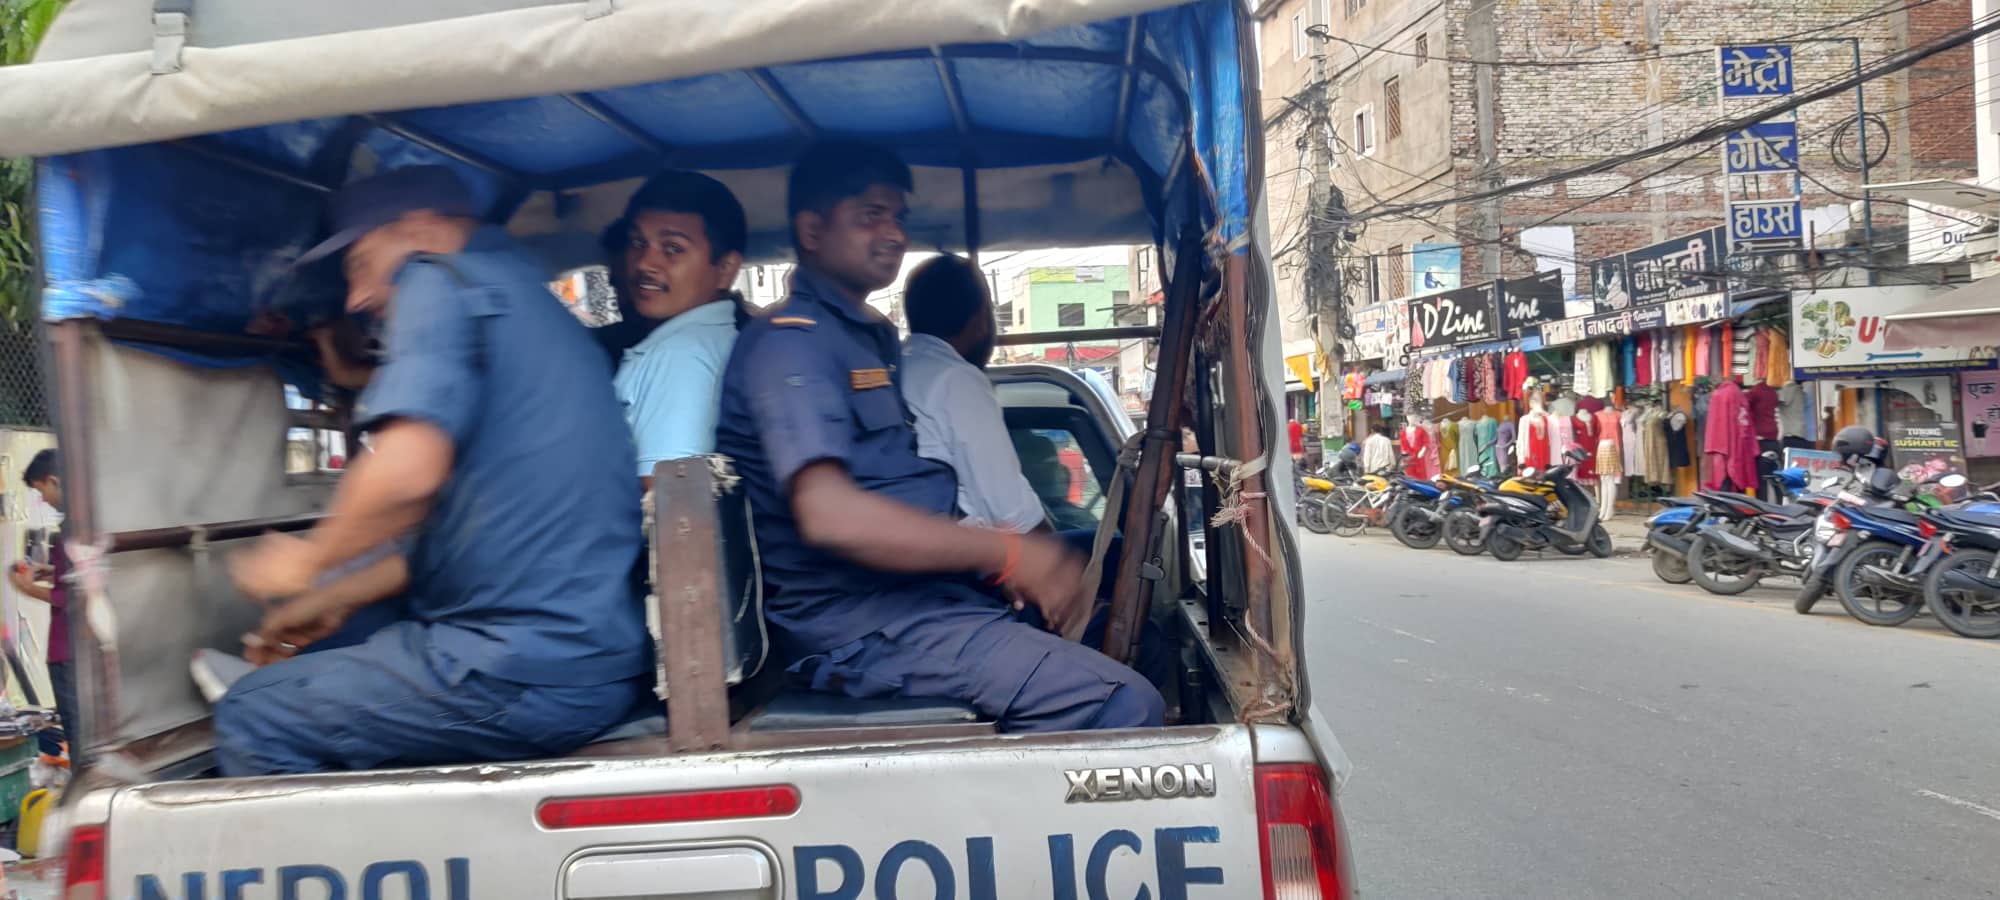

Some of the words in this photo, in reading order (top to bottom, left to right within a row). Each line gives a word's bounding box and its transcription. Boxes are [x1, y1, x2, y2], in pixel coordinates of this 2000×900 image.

[1724, 49, 1789, 92] मेट्रो
[1733, 204, 1796, 234] हाउस
[1064, 763, 1216, 803] XENON
